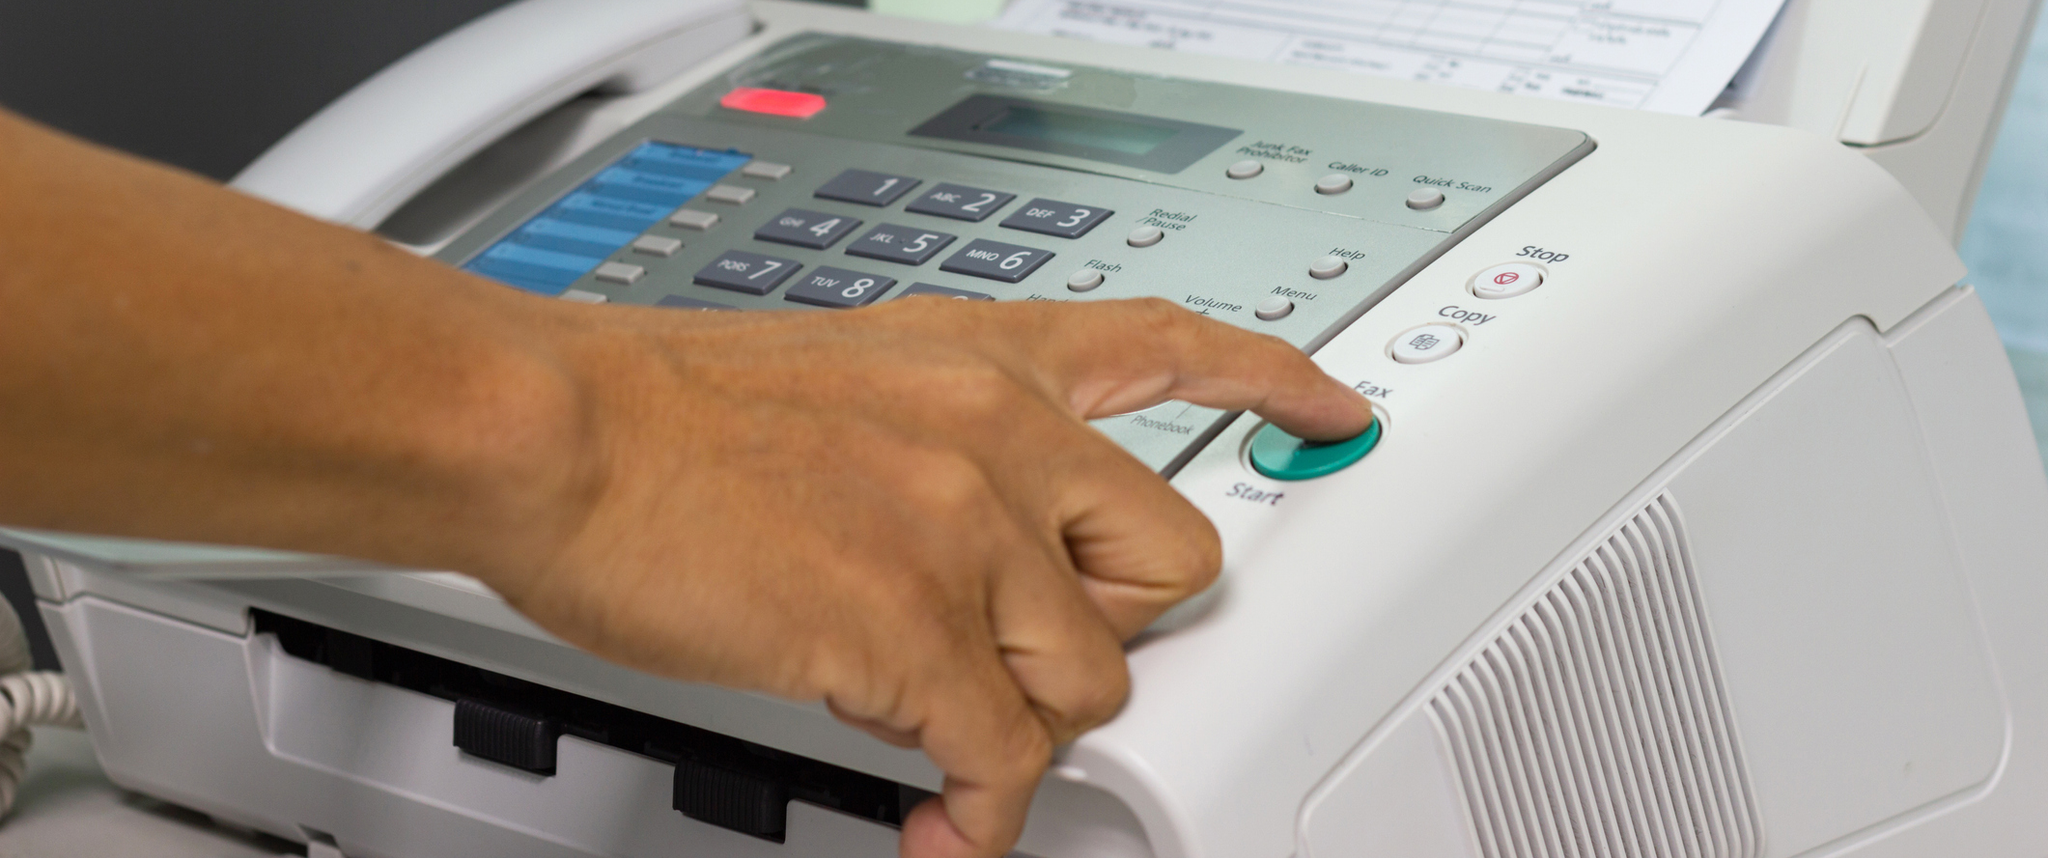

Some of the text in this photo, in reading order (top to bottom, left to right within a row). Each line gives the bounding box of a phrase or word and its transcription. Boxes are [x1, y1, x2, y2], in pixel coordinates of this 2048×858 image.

[1235, 146, 1308, 164] Prohibitor
[1250, 140, 1313, 156] Junk Fax
[1328, 161, 1389, 177] Caller ID
[873, 178, 898, 196] 1
[1412, 174, 1492, 194] Quick Scan
[930, 191, 997, 212] ABC 2
[1026, 207, 1091, 228] DEF 3
[1135, 217, 1187, 231] /Pause
[1150, 208, 1198, 223] Redial
[779, 216, 842, 237] GHI 4
[869, 232, 939, 253] JKL 5
[966, 248, 1032, 270] MNO 6
[1329, 247, 1366, 261] Help
[1516, 245, 1570, 264] Stop
[717, 259, 783, 280] PQRS 7
[1083, 258, 1122, 274] Flash
[810, 276, 875, 298] TUV 8
[1270, 285, 1318, 301] Menu
[1184, 294, 1243, 313] Volume
[1438, 305, 1497, 326] Copy
[1353, 380, 1394, 399] Fax
[1130, 414, 1196, 435] Phonebook
[1226, 482, 1285, 506] Start
